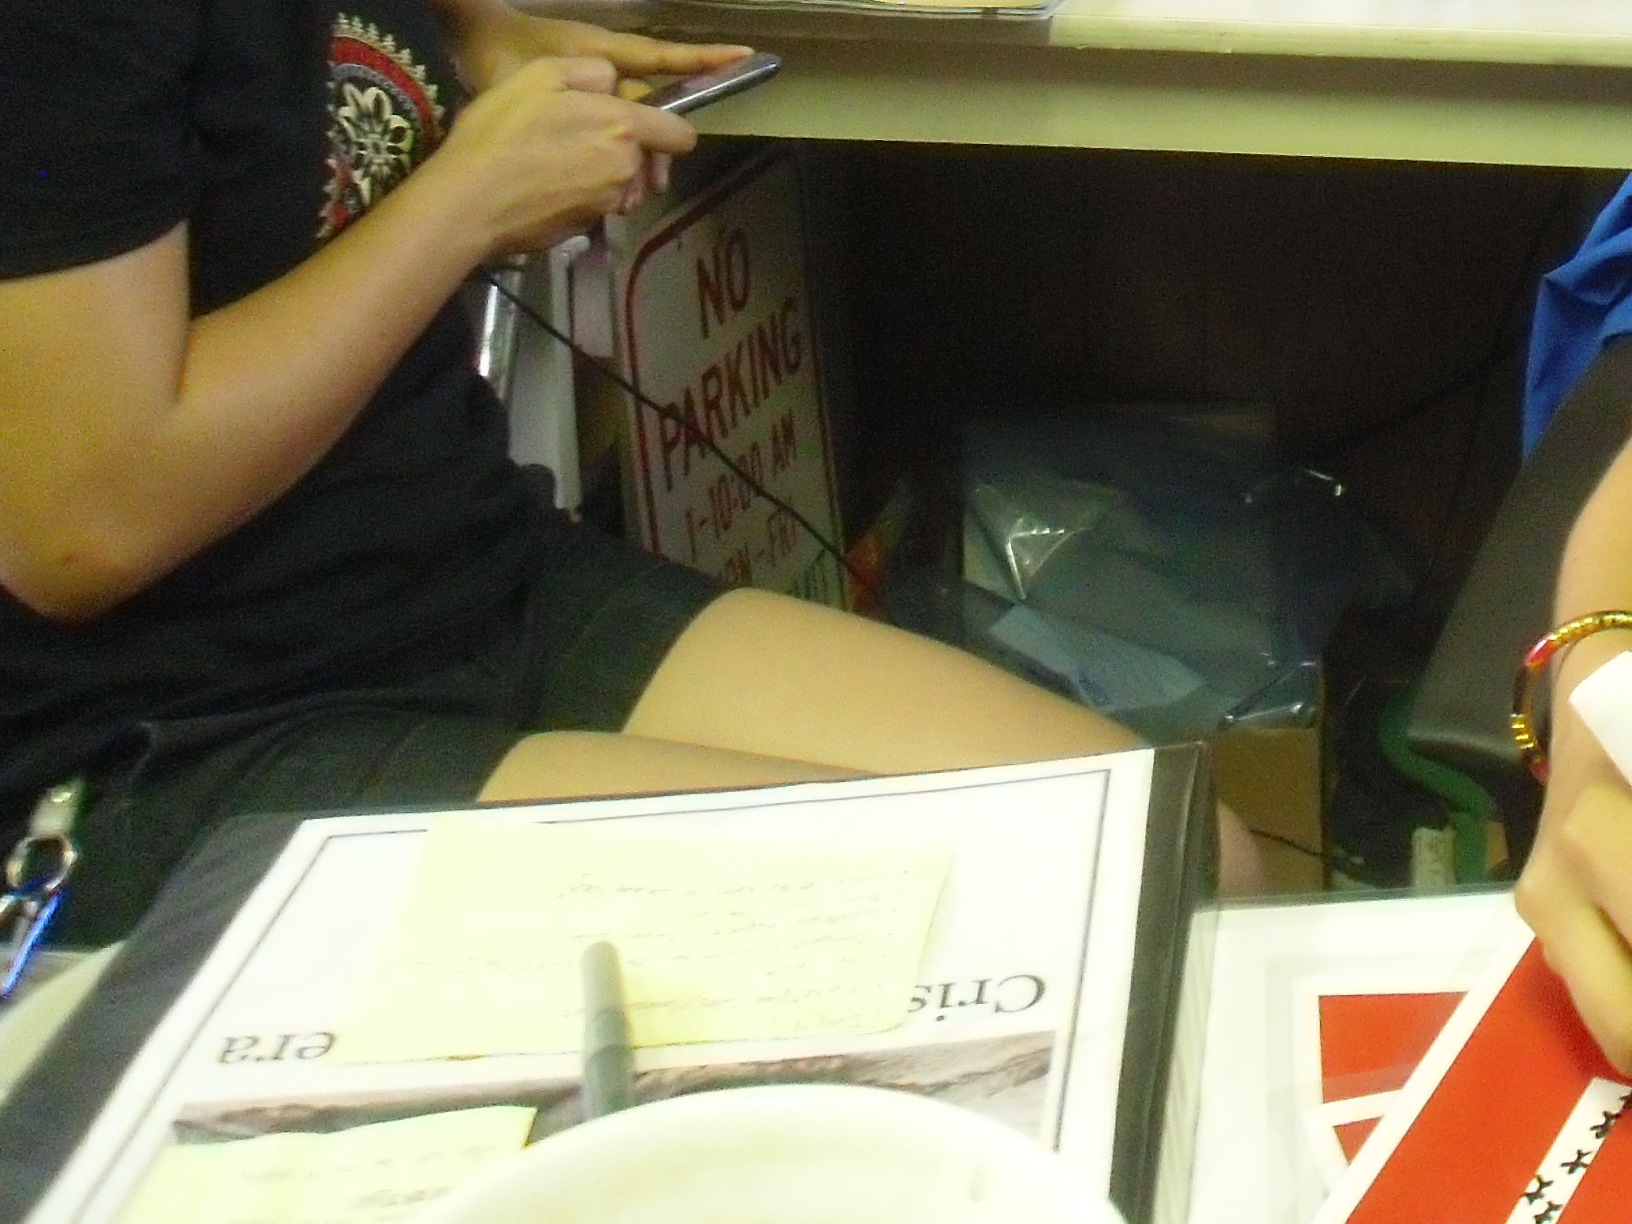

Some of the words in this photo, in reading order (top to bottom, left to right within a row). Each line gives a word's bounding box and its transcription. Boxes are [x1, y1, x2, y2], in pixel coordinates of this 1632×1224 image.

[696, 227, 751, 340] NO
[657, 299, 801, 492] PARKING
[907, 974, 1046, 1022] Cris
[218, 1030, 337, 1065] era
